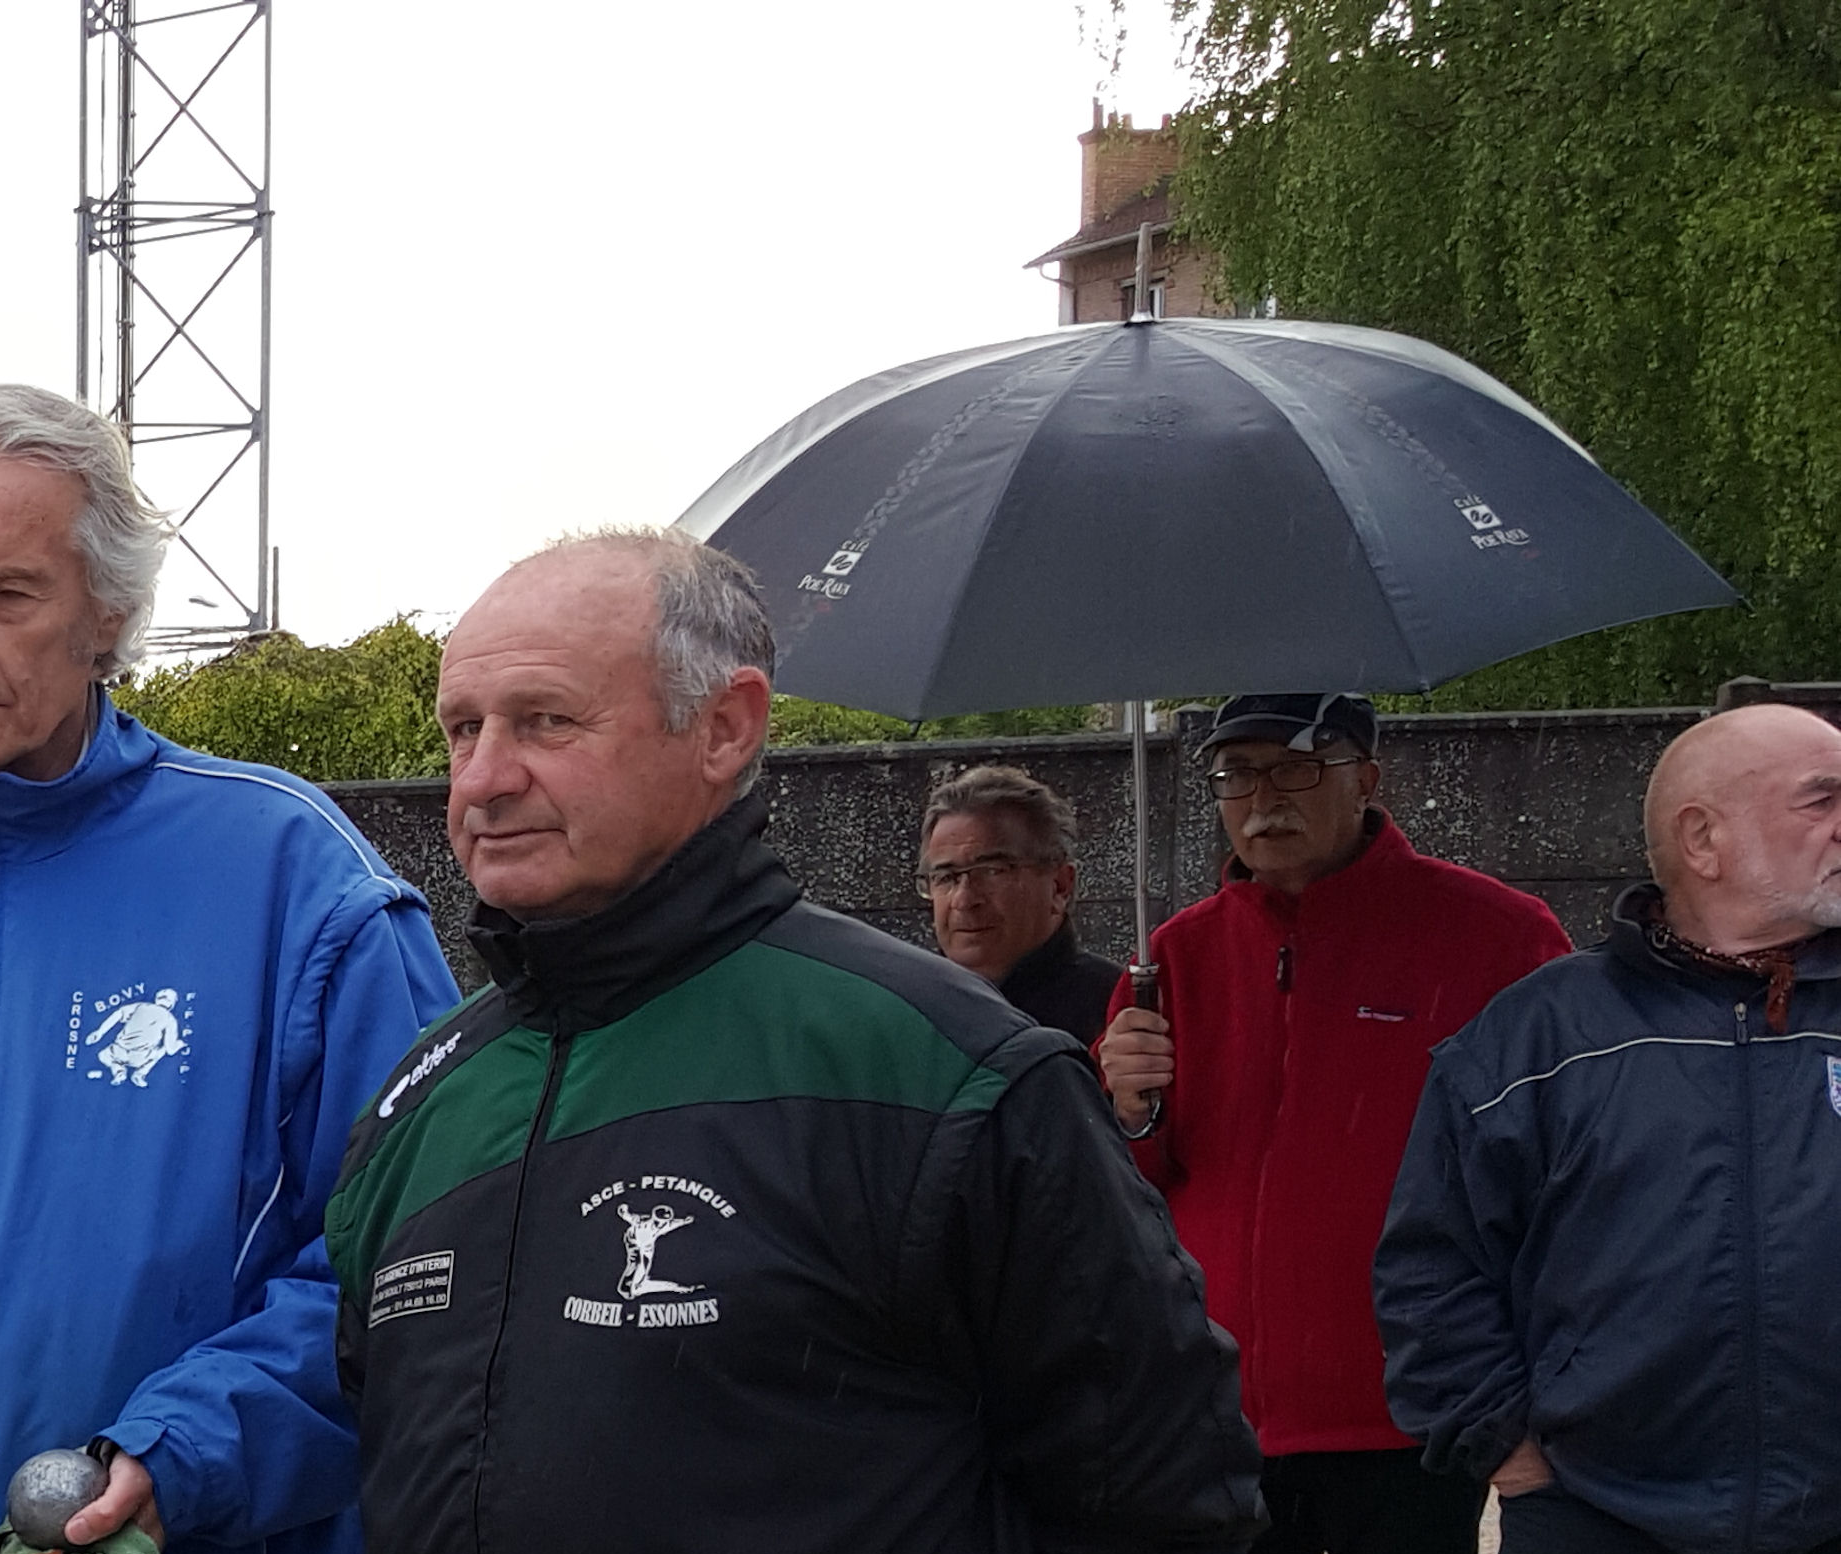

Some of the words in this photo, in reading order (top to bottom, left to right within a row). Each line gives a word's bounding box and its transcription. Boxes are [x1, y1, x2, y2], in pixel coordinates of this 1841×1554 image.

[66, 991, 83, 1069] CROSNE
[580, 1181, 625, 1217] ASCE
[641, 1175, 737, 1218] PETANQUE
[564, 1296, 623, 1327] CORBEIL
[638, 1299, 719, 1328] ESSONNES
